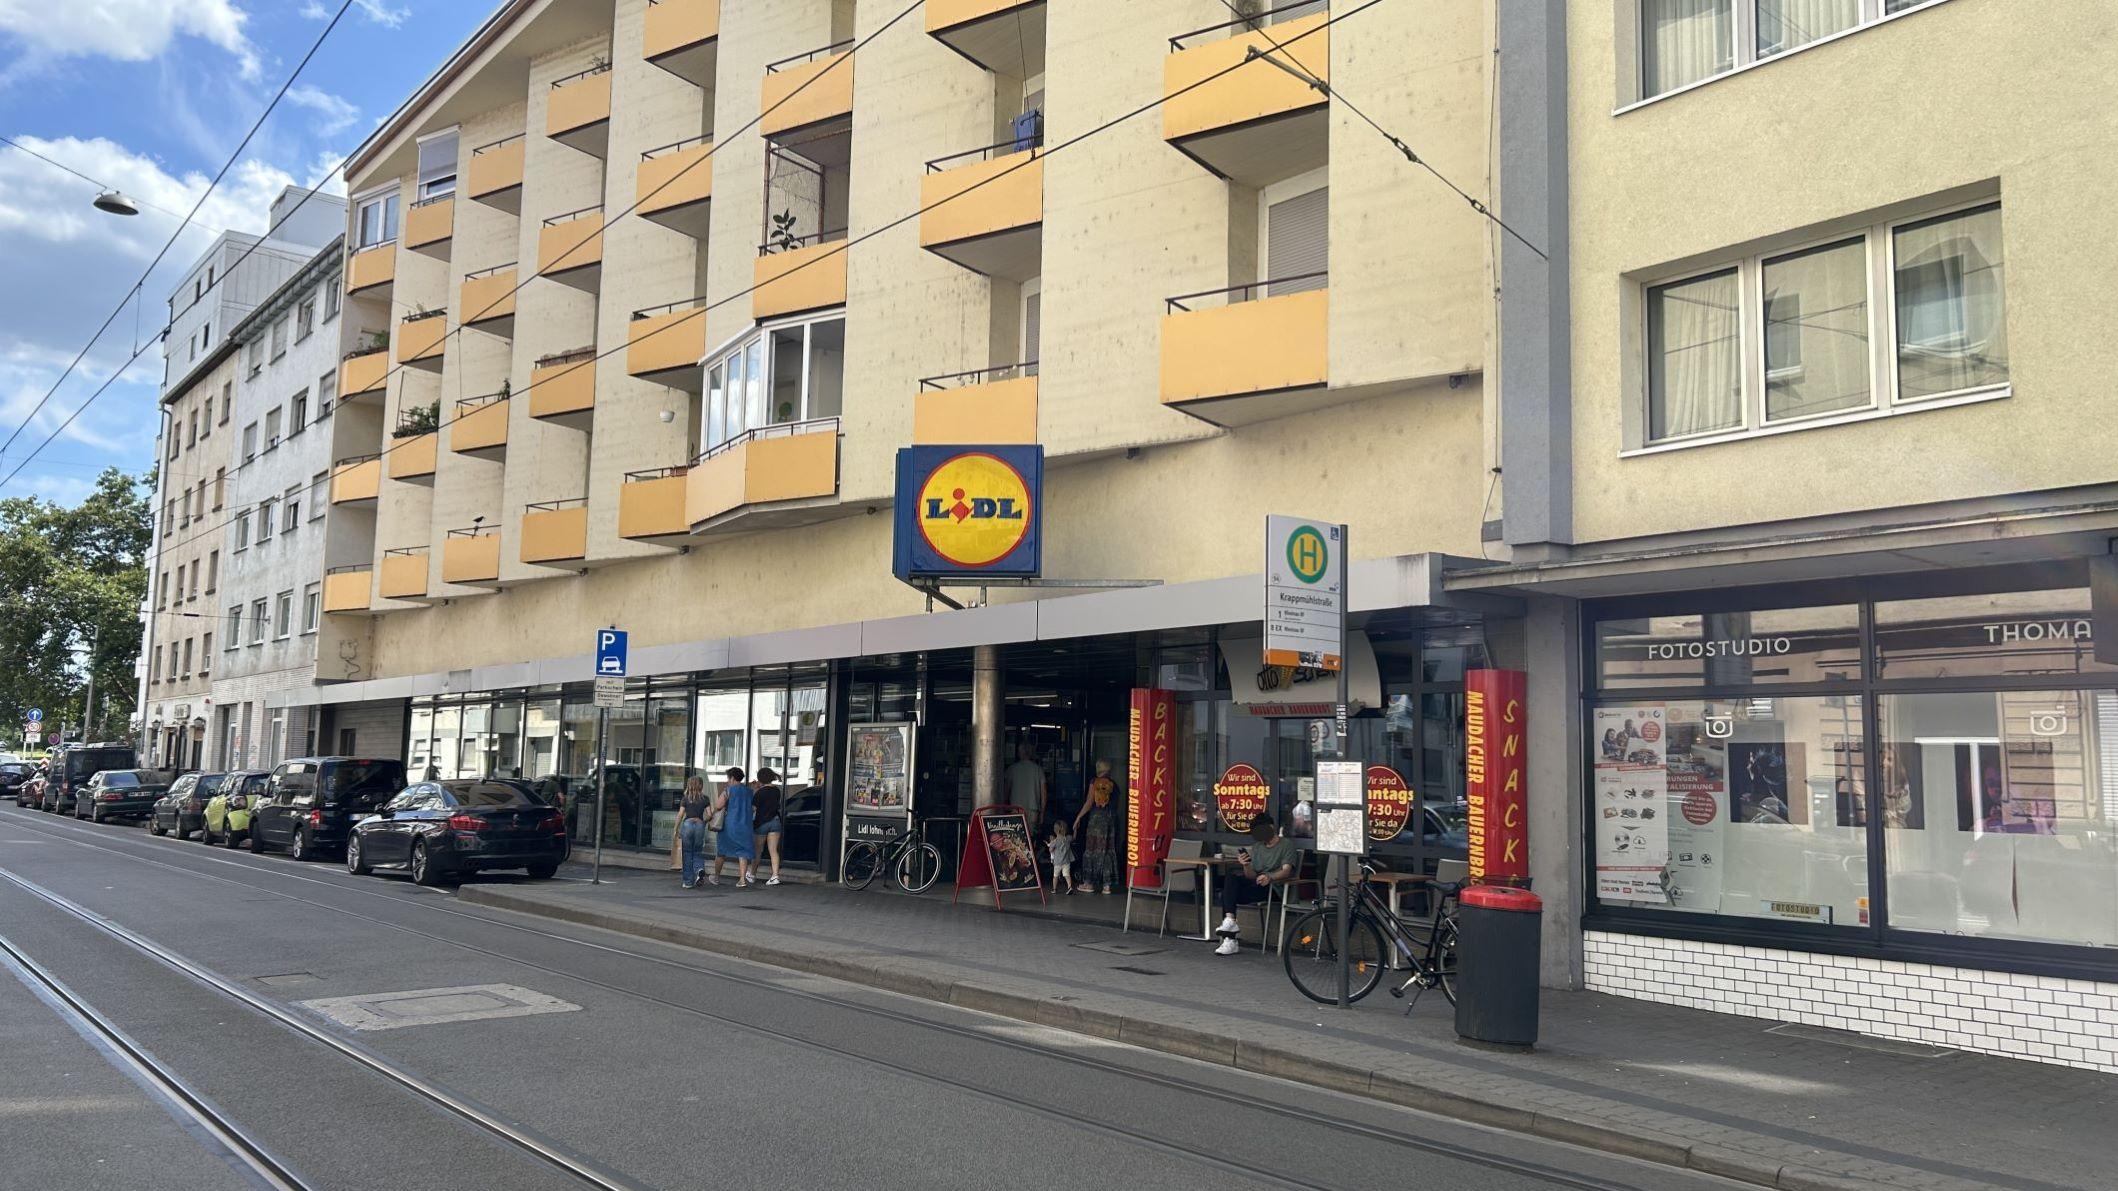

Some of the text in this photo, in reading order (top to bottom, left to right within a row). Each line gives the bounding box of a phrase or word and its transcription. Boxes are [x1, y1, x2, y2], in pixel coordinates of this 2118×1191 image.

[1300, 537, 1318, 572] H
[1279, 591, 1333, 607] Krappmühlstraße
[1983, 620, 2092, 643] THOMA
[602, 632, 615, 650] P
[1648, 637, 1790, 660] FOTOSTUDIO
[1467, 690, 1485, 784] MAUDACHER
[1228, 773, 1256, 782] Wir sind
[1379, 775, 1397, 785] sind
[1127, 708, 1141, 867] MAUDACHER BAUERNBROT
[1213, 783, 1271, 800] Sonntags
[1230, 798, 1253, 810] 7:30
[1253, 802, 1264, 810] Uhr
[1393, 808, 1406, 816] Uhr
[1237, 811, 1248, 820] Sie
[1374, 819, 1386, 827] Sie
[1387, 818, 1398, 828] da
[857, 823, 869, 834] Lidl
